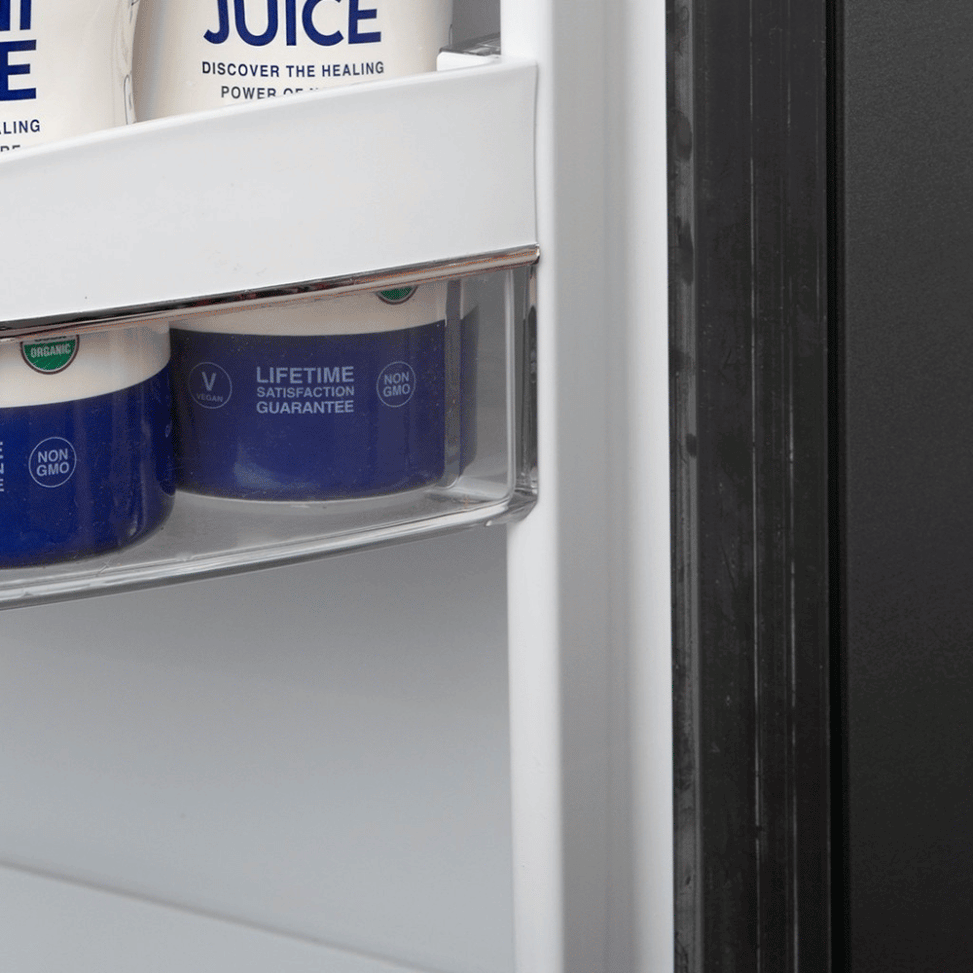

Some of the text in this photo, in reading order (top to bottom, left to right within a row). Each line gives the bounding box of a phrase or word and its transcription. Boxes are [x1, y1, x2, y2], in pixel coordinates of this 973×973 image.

[202, 61, 385, 78] DISCOVER THE HEALING
[221, 85, 277, 100] POWER
[30, 343, 71, 359] ORGANIC
[256, 366, 355, 383] LIFETIME
[383, 371, 409, 385] NON
[257, 385, 355, 398] SATISFACTION
[383, 383, 411, 397] GMO
[195, 393, 224, 403] VEGAN
[256, 400, 355, 415] GUARANTEE
[37, 449, 69, 465] NON
[36, 462, 70, 477] GMO
